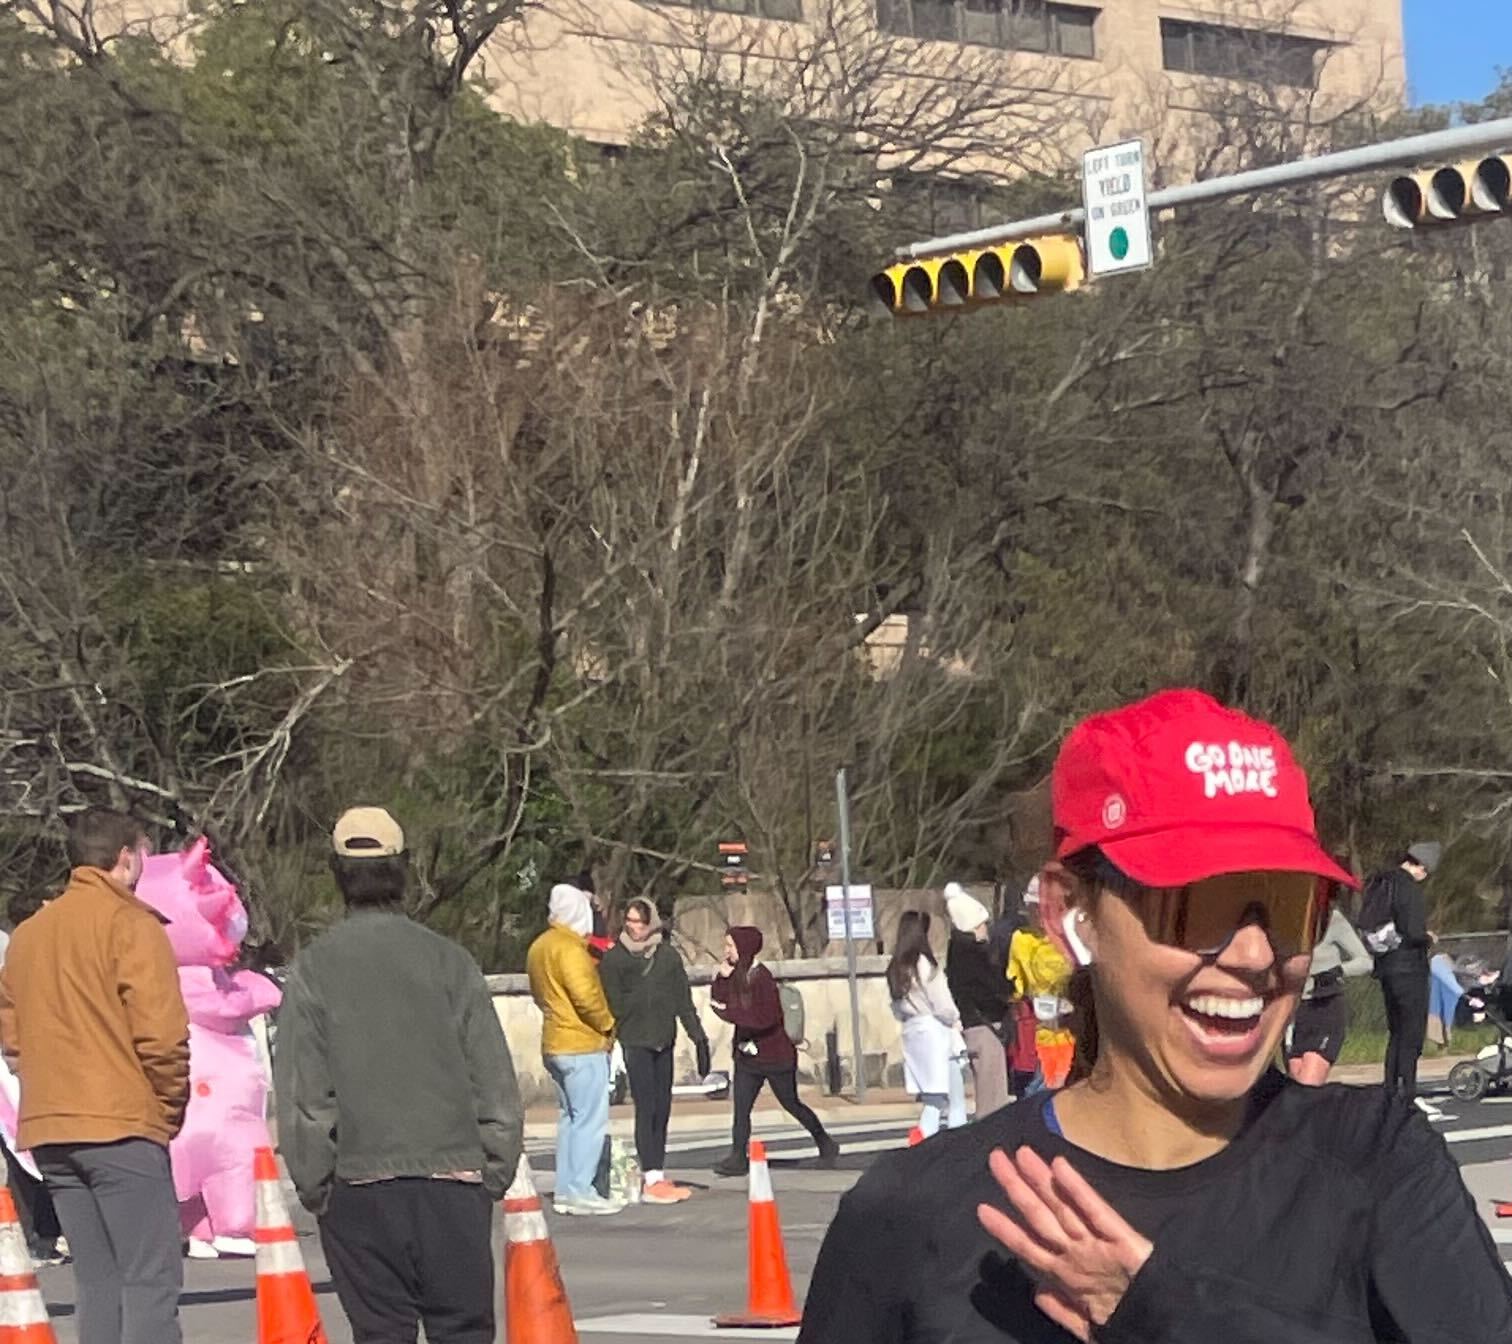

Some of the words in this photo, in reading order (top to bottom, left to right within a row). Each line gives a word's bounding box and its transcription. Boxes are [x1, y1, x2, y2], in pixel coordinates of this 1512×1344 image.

[1185, 741, 1226, 773] GO
[1227, 740, 1277, 774] ONE
[1204, 768, 1277, 799] MORE
